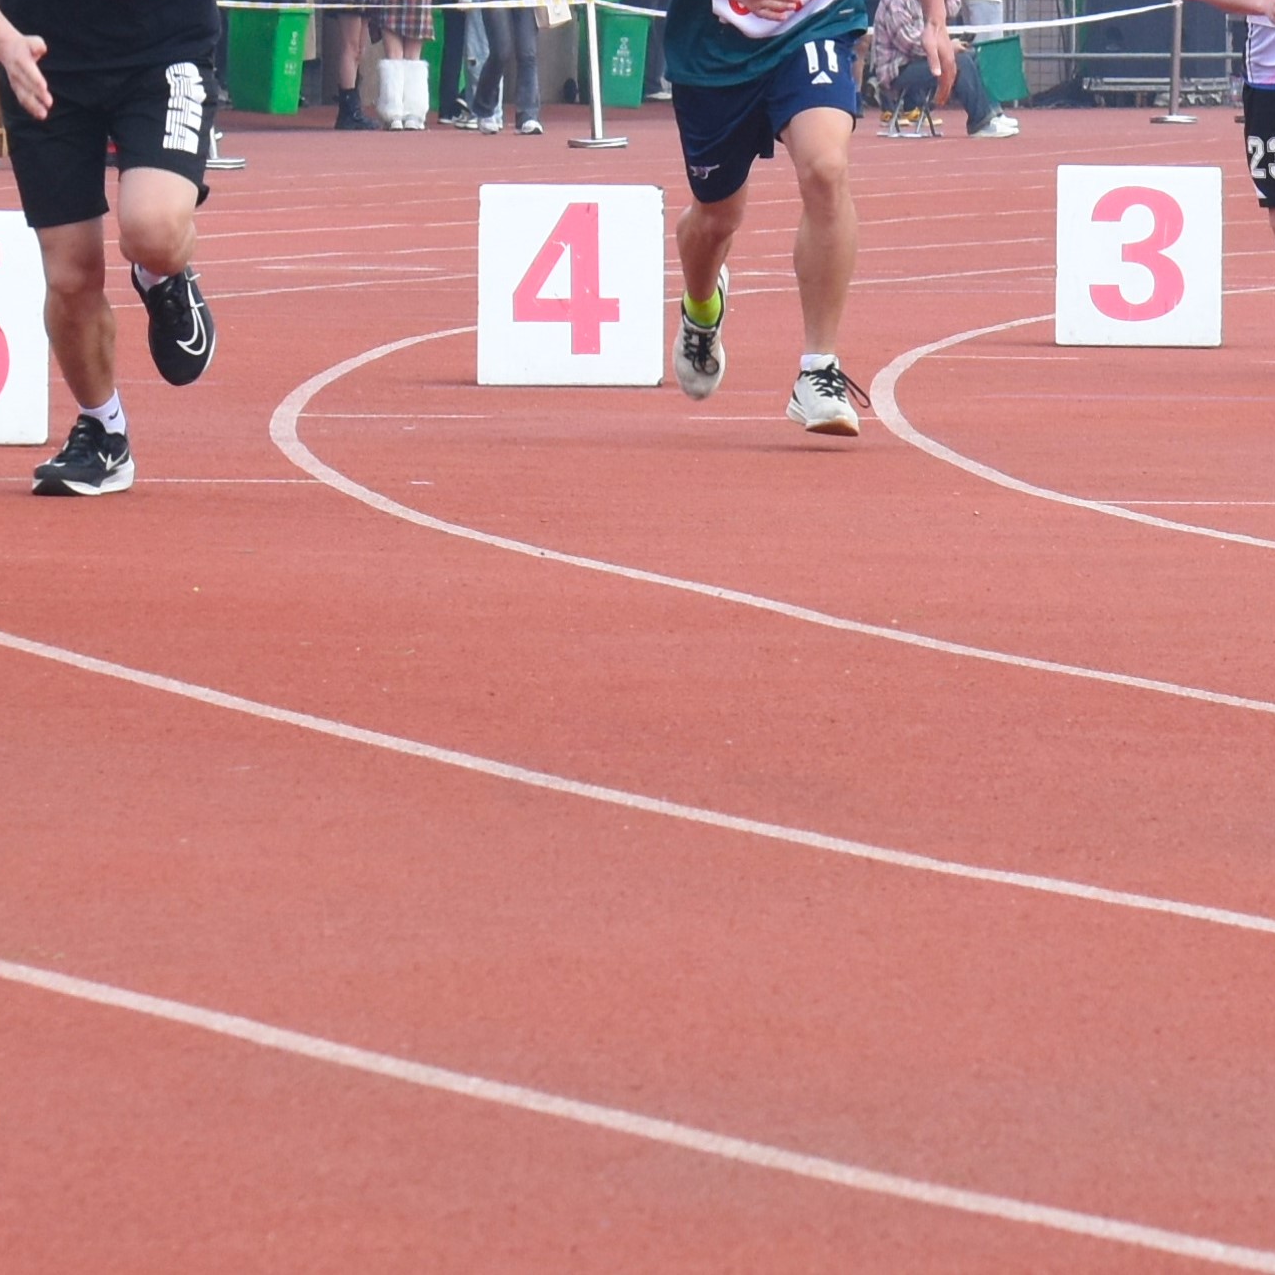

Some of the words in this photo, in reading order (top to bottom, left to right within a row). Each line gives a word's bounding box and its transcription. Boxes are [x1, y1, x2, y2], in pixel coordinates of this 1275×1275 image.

[803, 39, 839, 74] 11
[512, 202, 620, 355] 4
[1088, 186, 1186, 322] 3
